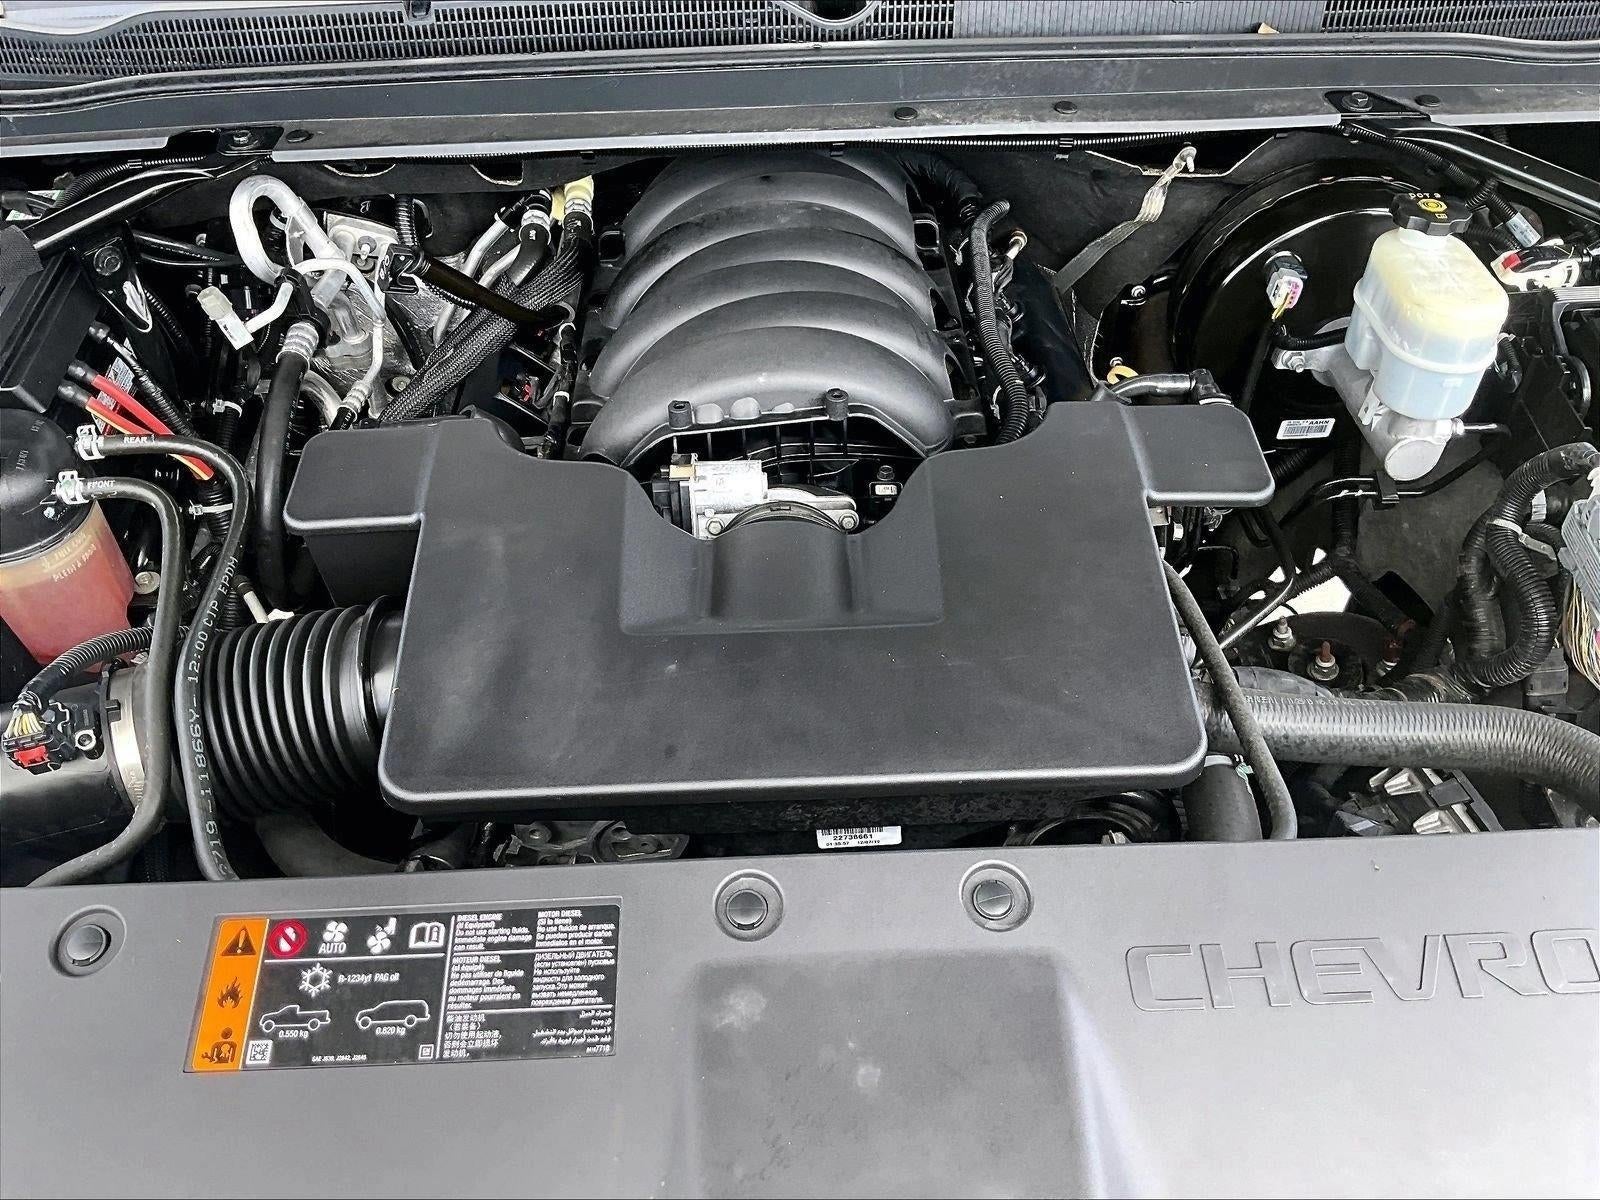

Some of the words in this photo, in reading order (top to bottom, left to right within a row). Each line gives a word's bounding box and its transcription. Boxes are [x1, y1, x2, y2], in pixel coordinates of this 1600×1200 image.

[87, 480, 115, 489] FRONT
[218, 556, 238, 595] EPDM
[318, 942, 347, 954] AUTO
[374, 973, 389, 982] PAG
[299, 1030, 309, 1039] kg
[395, 1026, 406, 1036] kg
